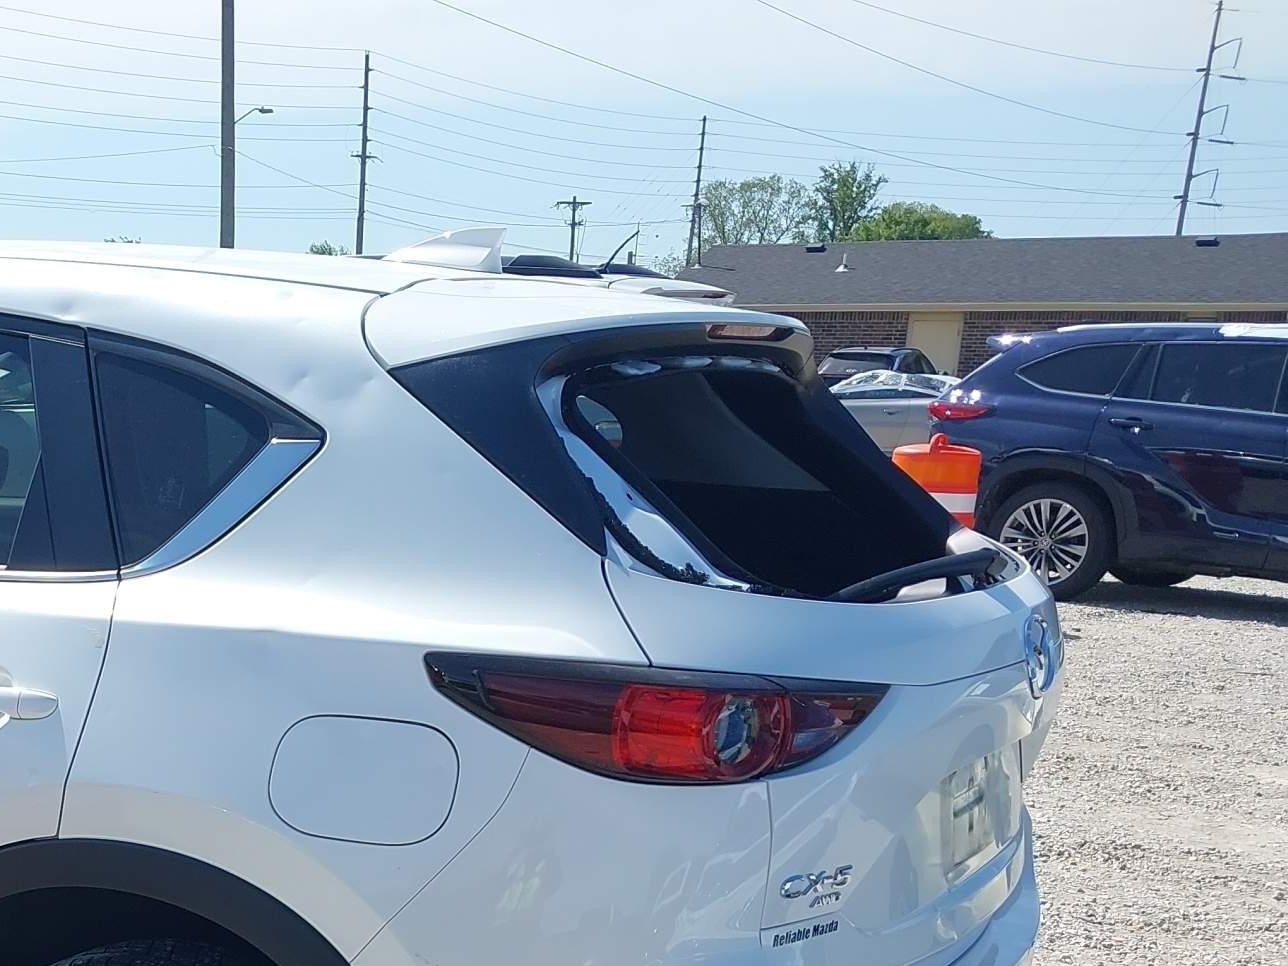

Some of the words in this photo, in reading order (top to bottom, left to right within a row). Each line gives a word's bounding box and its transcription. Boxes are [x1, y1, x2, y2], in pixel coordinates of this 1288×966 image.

[779, 864, 853, 899] CX-5
[809, 891, 841, 907] AWD
[772, 928, 810, 947] Reliable
[811, 919, 839, 938] Mazda
